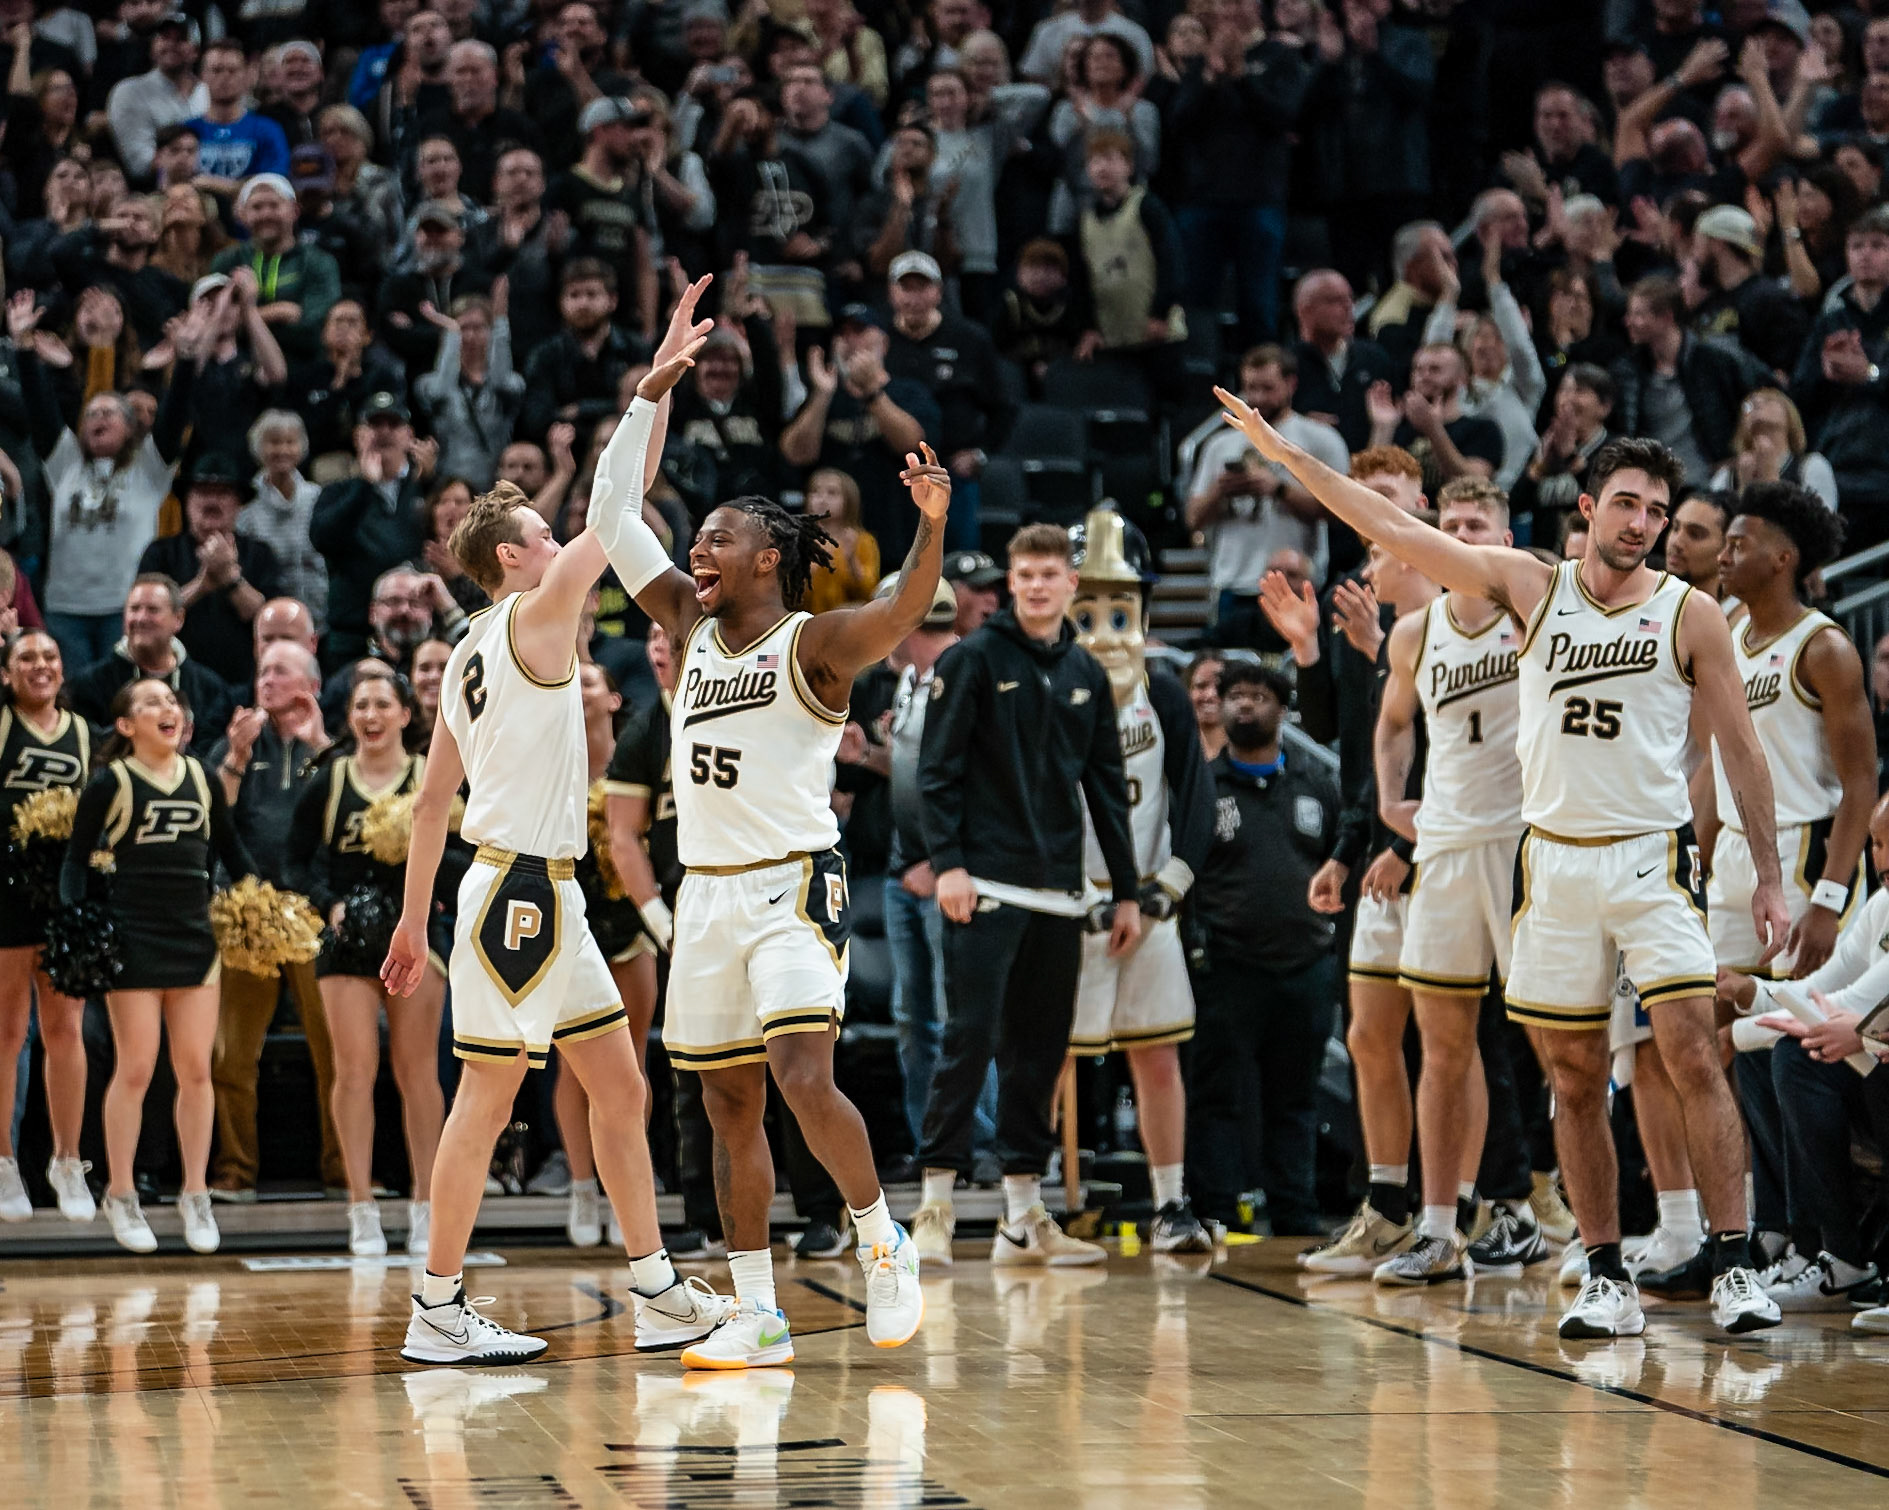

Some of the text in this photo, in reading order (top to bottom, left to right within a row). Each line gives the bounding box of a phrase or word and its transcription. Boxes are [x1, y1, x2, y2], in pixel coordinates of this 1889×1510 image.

[461, 650, 488, 724] 2
[1430, 648, 1520, 711] Purdue
[1545, 631, 1659, 698] Purdue
[683, 664, 778, 730] Purdue
[1745, 671, 1781, 710] due
[1468, 709, 1484, 744] 1
[1560, 695, 1624, 740] 25
[4, 746, 82, 790] P
[689, 741, 742, 790] 55
[134, 800, 205, 845] P
[823, 872, 843, 924] P
[503, 899, 543, 951] P
